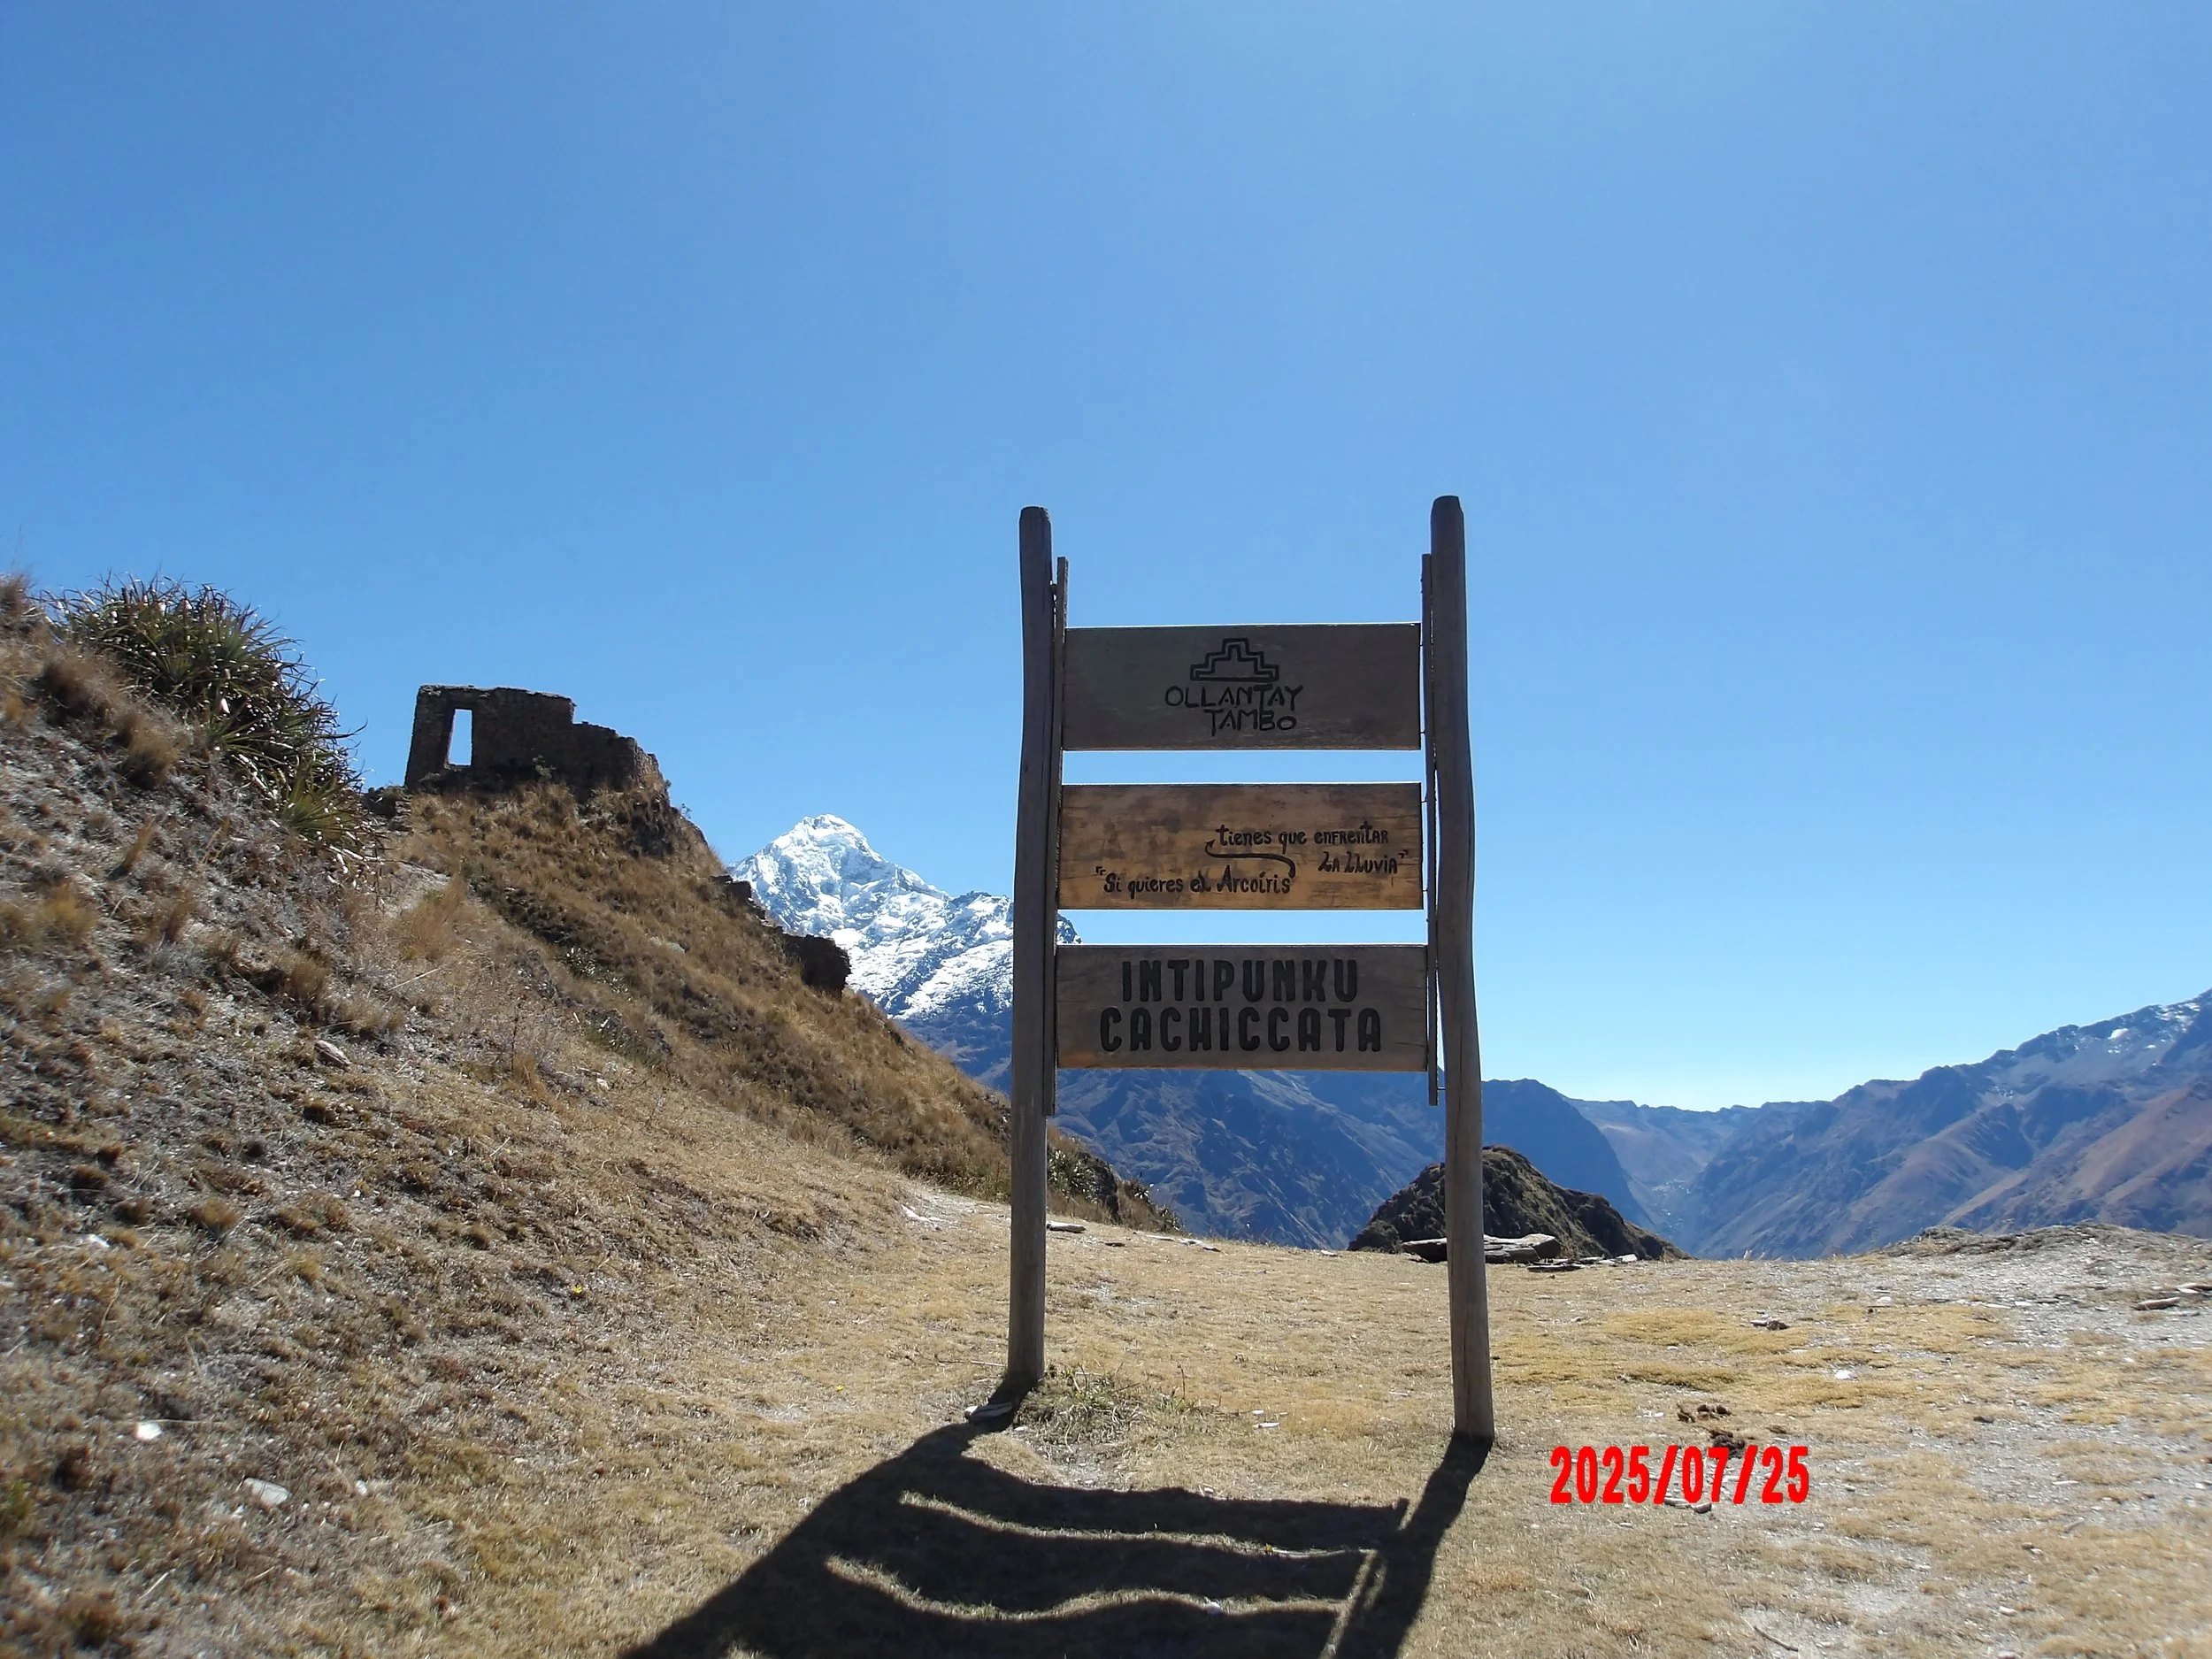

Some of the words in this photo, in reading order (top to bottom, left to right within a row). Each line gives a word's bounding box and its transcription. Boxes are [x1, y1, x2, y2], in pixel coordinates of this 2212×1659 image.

[1164, 684, 1303, 711] OLLANTAY
[1203, 709, 1297, 736] TAMBO
[1215, 824, 1271, 846] tienes
[1278, 830, 1308, 855] que
[1127, 875, 1184, 899] quieres
[1189, 870, 1211, 893] el
[1217, 864, 1291, 894] Arcoíris
[1122, 958, 1359, 1002] INTIPUNKU
[1100, 1007, 1381, 1052] CACHICCATA
